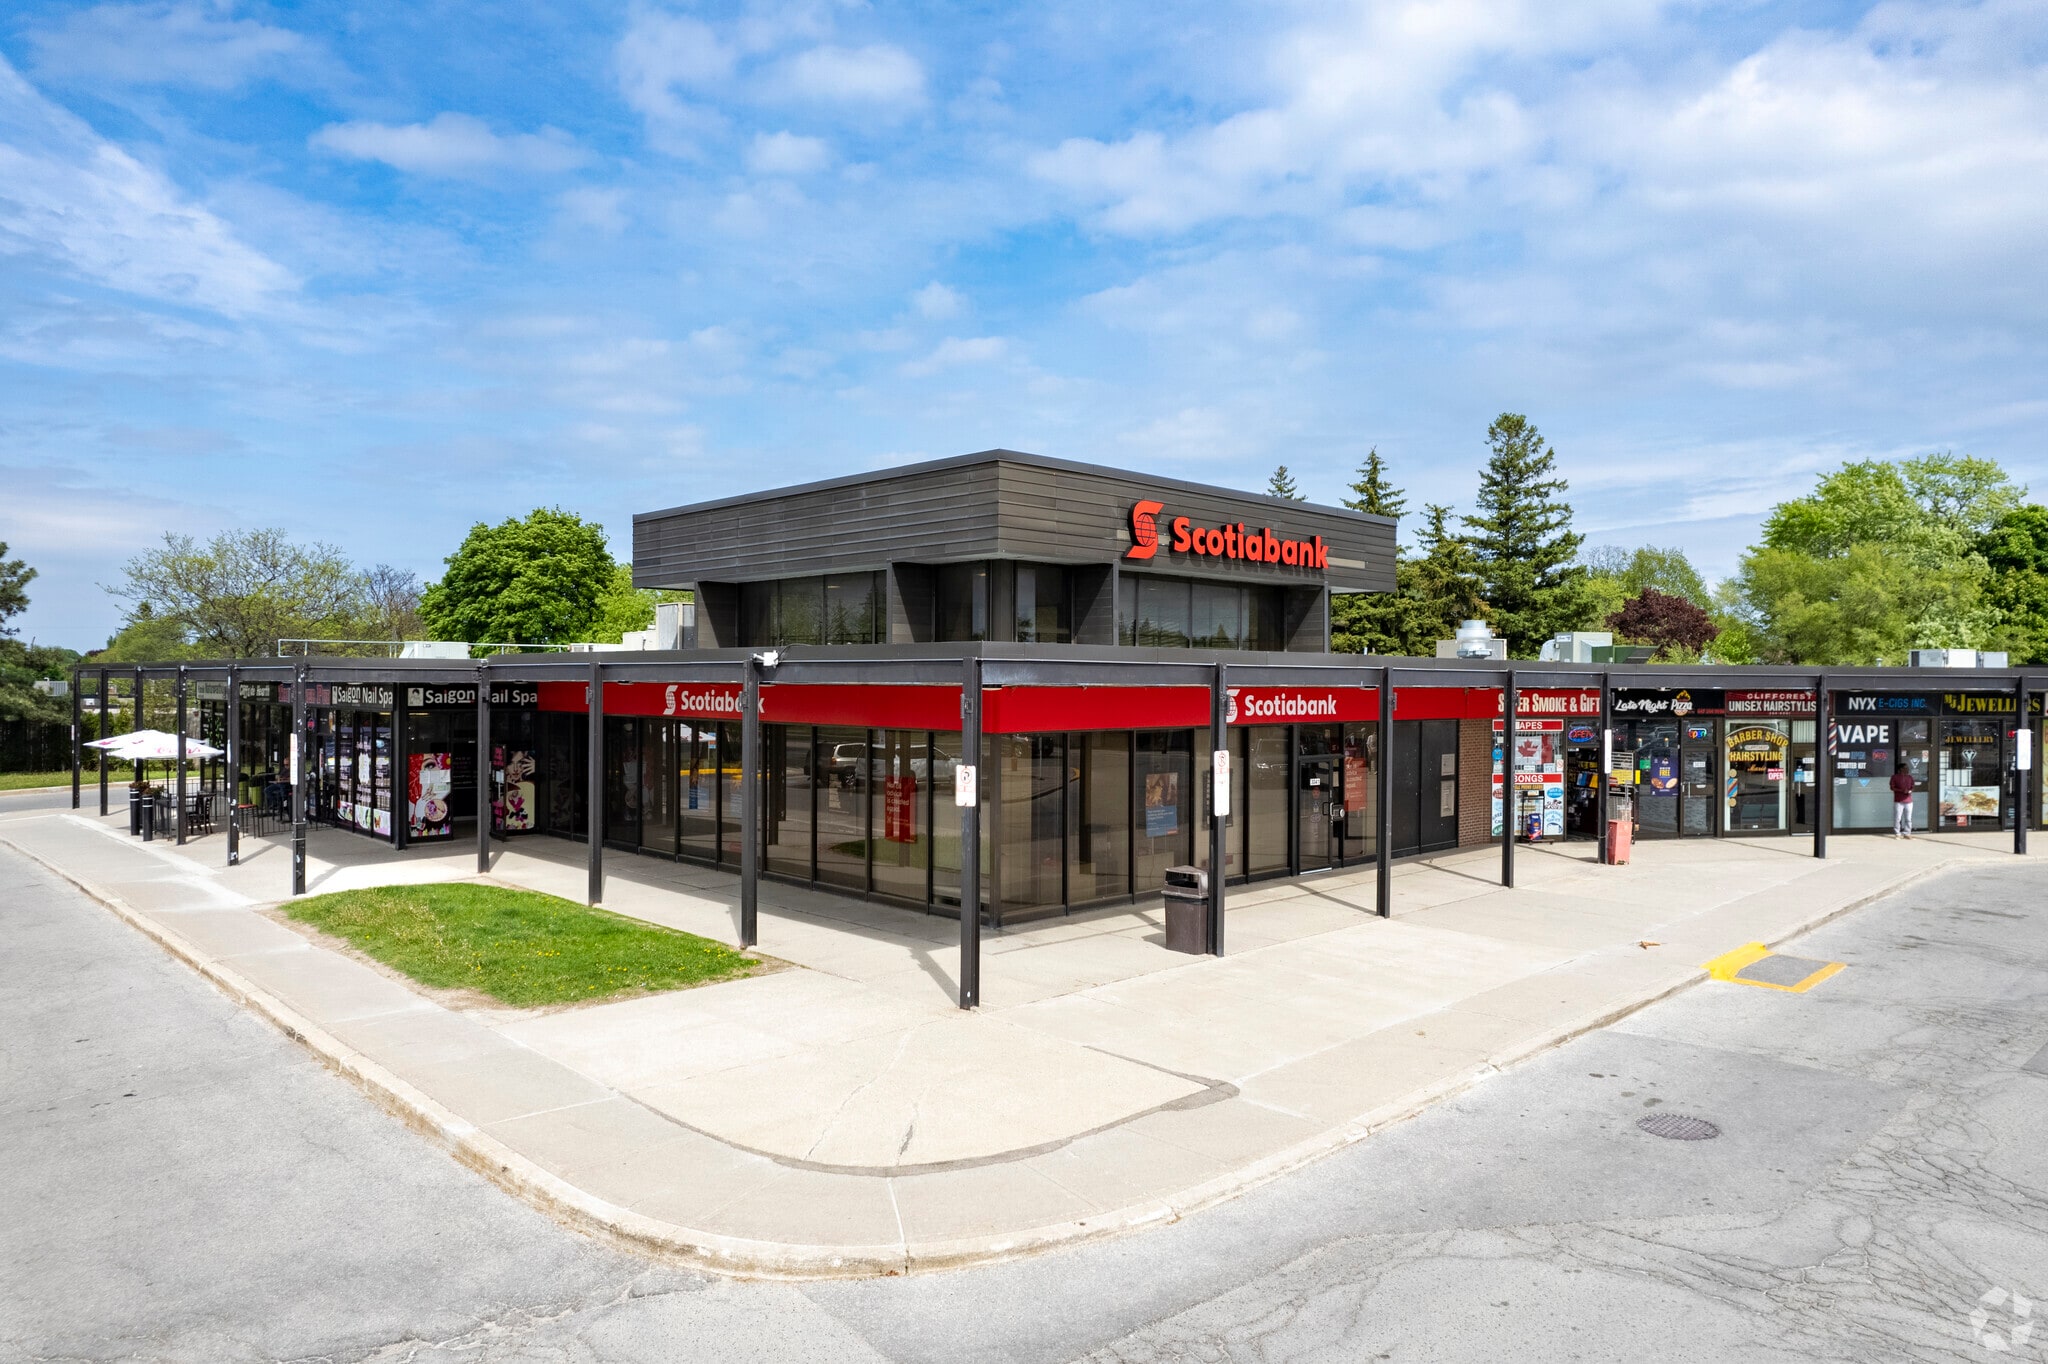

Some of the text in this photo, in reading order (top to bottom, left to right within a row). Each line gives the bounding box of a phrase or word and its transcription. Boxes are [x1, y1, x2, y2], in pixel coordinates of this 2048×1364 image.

[1173, 516, 1329, 569] Scotiabank
[338, 686, 361, 703] Saigon
[362, 688, 377, 703] Nail
[378, 690, 393, 708] Spa
[425, 689, 538, 706] Saigon ail Spa
[681, 689, 765, 713] Scotiabak
[1244, 693, 1337, 716] Scotiabank
[1498, 693, 1530, 712] SER
[1532, 693, 1567, 712] SMOKE
[1569, 697, 1577, 712] &
[1638, 699, 1669, 713] Night
[1728, 700, 1762, 712] UNISEX
[1763, 700, 1817, 712] HAIRSTYLIS
[1848, 697, 1877, 710] NYX
[1878, 698, 1909, 708] E-CIGS
[1957, 694, 2041, 712] JEWELLS
[1519, 721, 1543, 730] APES
[1837, 725, 1890, 743] VAPE
[1727, 730, 1789, 748] BARBER SHOP
[1728, 751, 1784, 762] HAIRSTYLING
